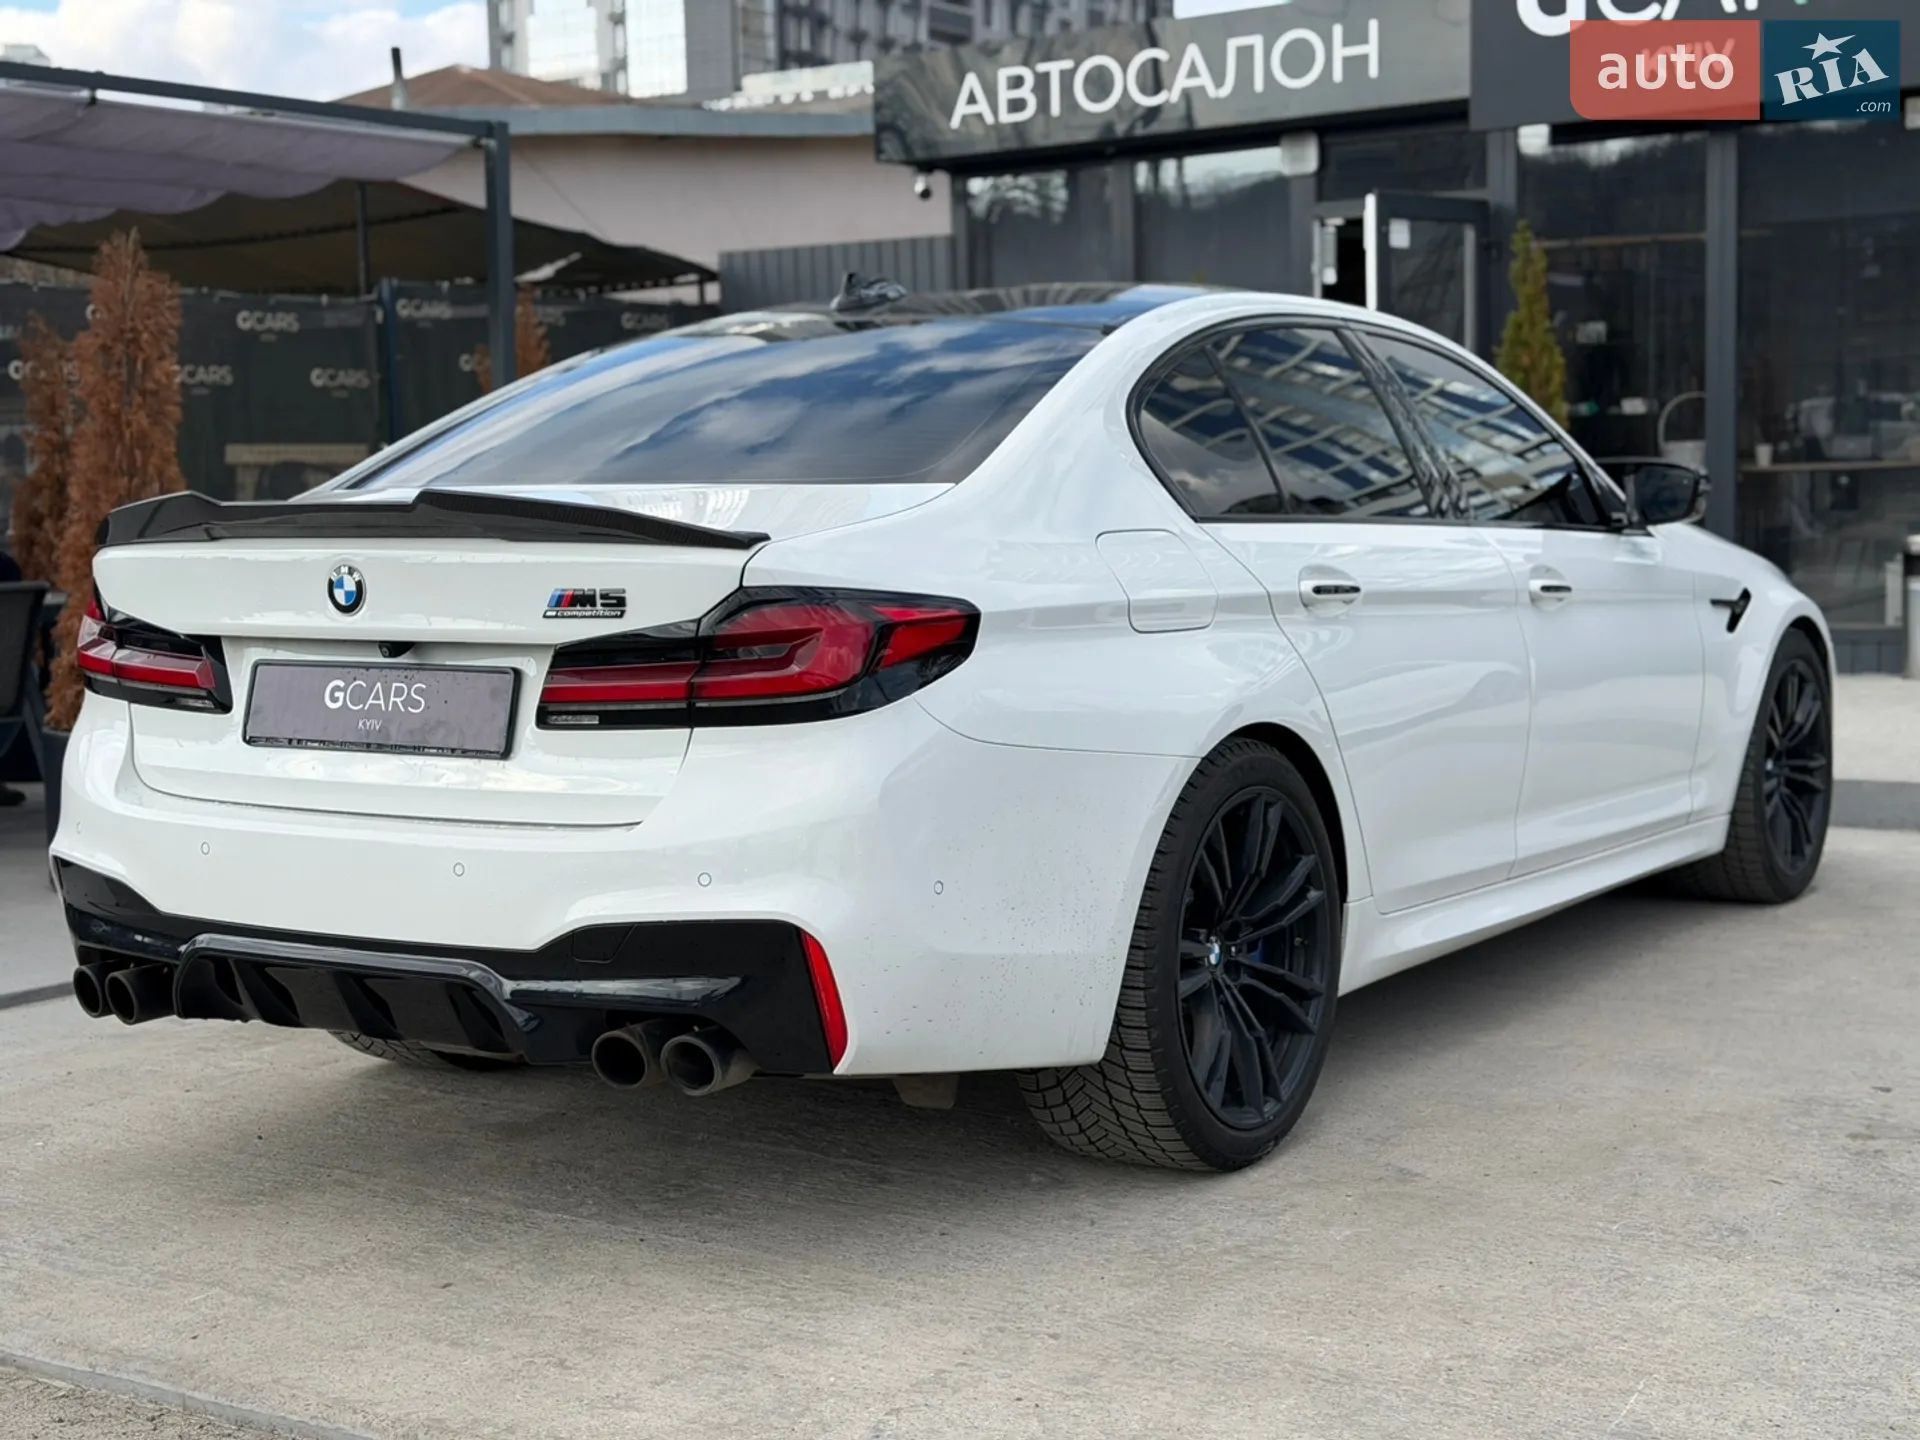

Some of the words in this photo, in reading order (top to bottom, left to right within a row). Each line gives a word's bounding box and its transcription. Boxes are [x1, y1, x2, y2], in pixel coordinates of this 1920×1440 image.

[948, 18, 1379, 130] АВТОСАЛОН
[236, 310, 299, 332] GCARS
[310, 367, 370, 388] GCARS
[560, 588, 627, 608] M5
[557, 609, 622, 618] competition
[324, 679, 427, 713] GCARS
[357, 717, 382, 731] KYIV
